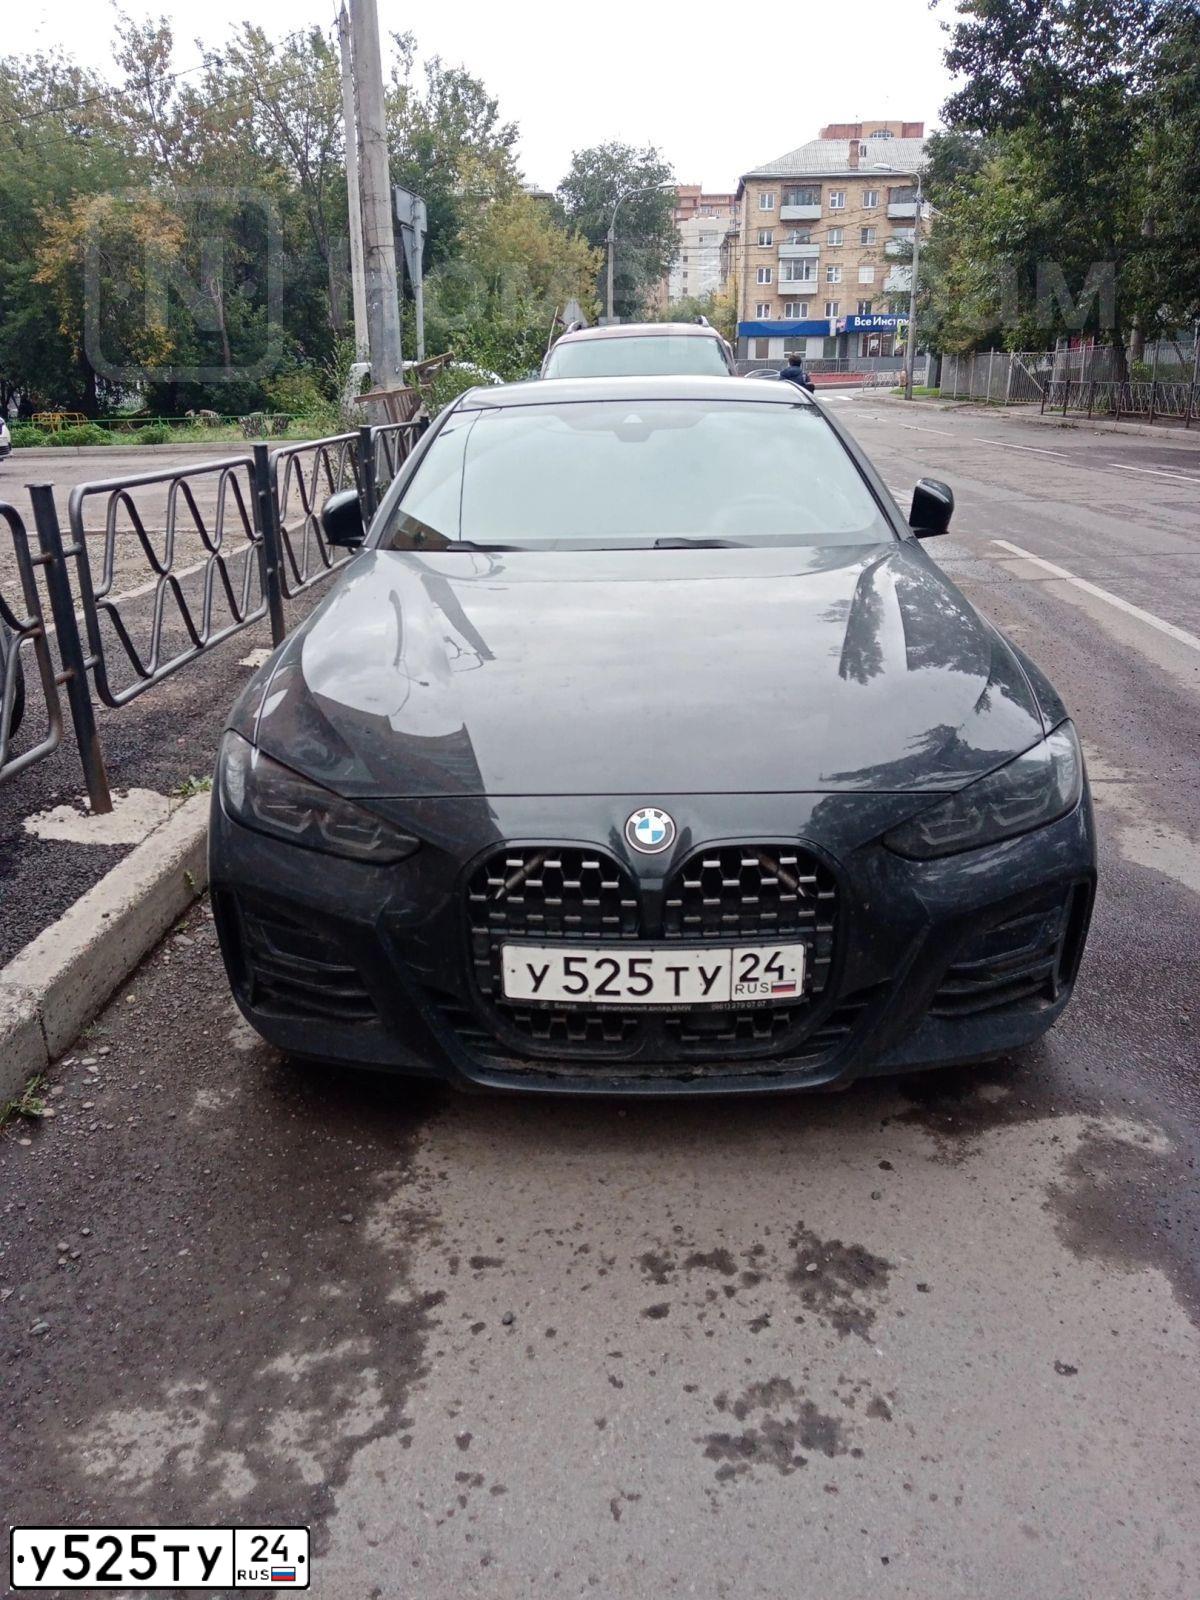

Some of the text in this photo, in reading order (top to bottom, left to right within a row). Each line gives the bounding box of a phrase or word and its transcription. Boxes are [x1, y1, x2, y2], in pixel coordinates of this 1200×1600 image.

[854, 316, 871, 327] Все
[738, 951, 785, 983] 24
[734, 982, 769, 995] RUS
